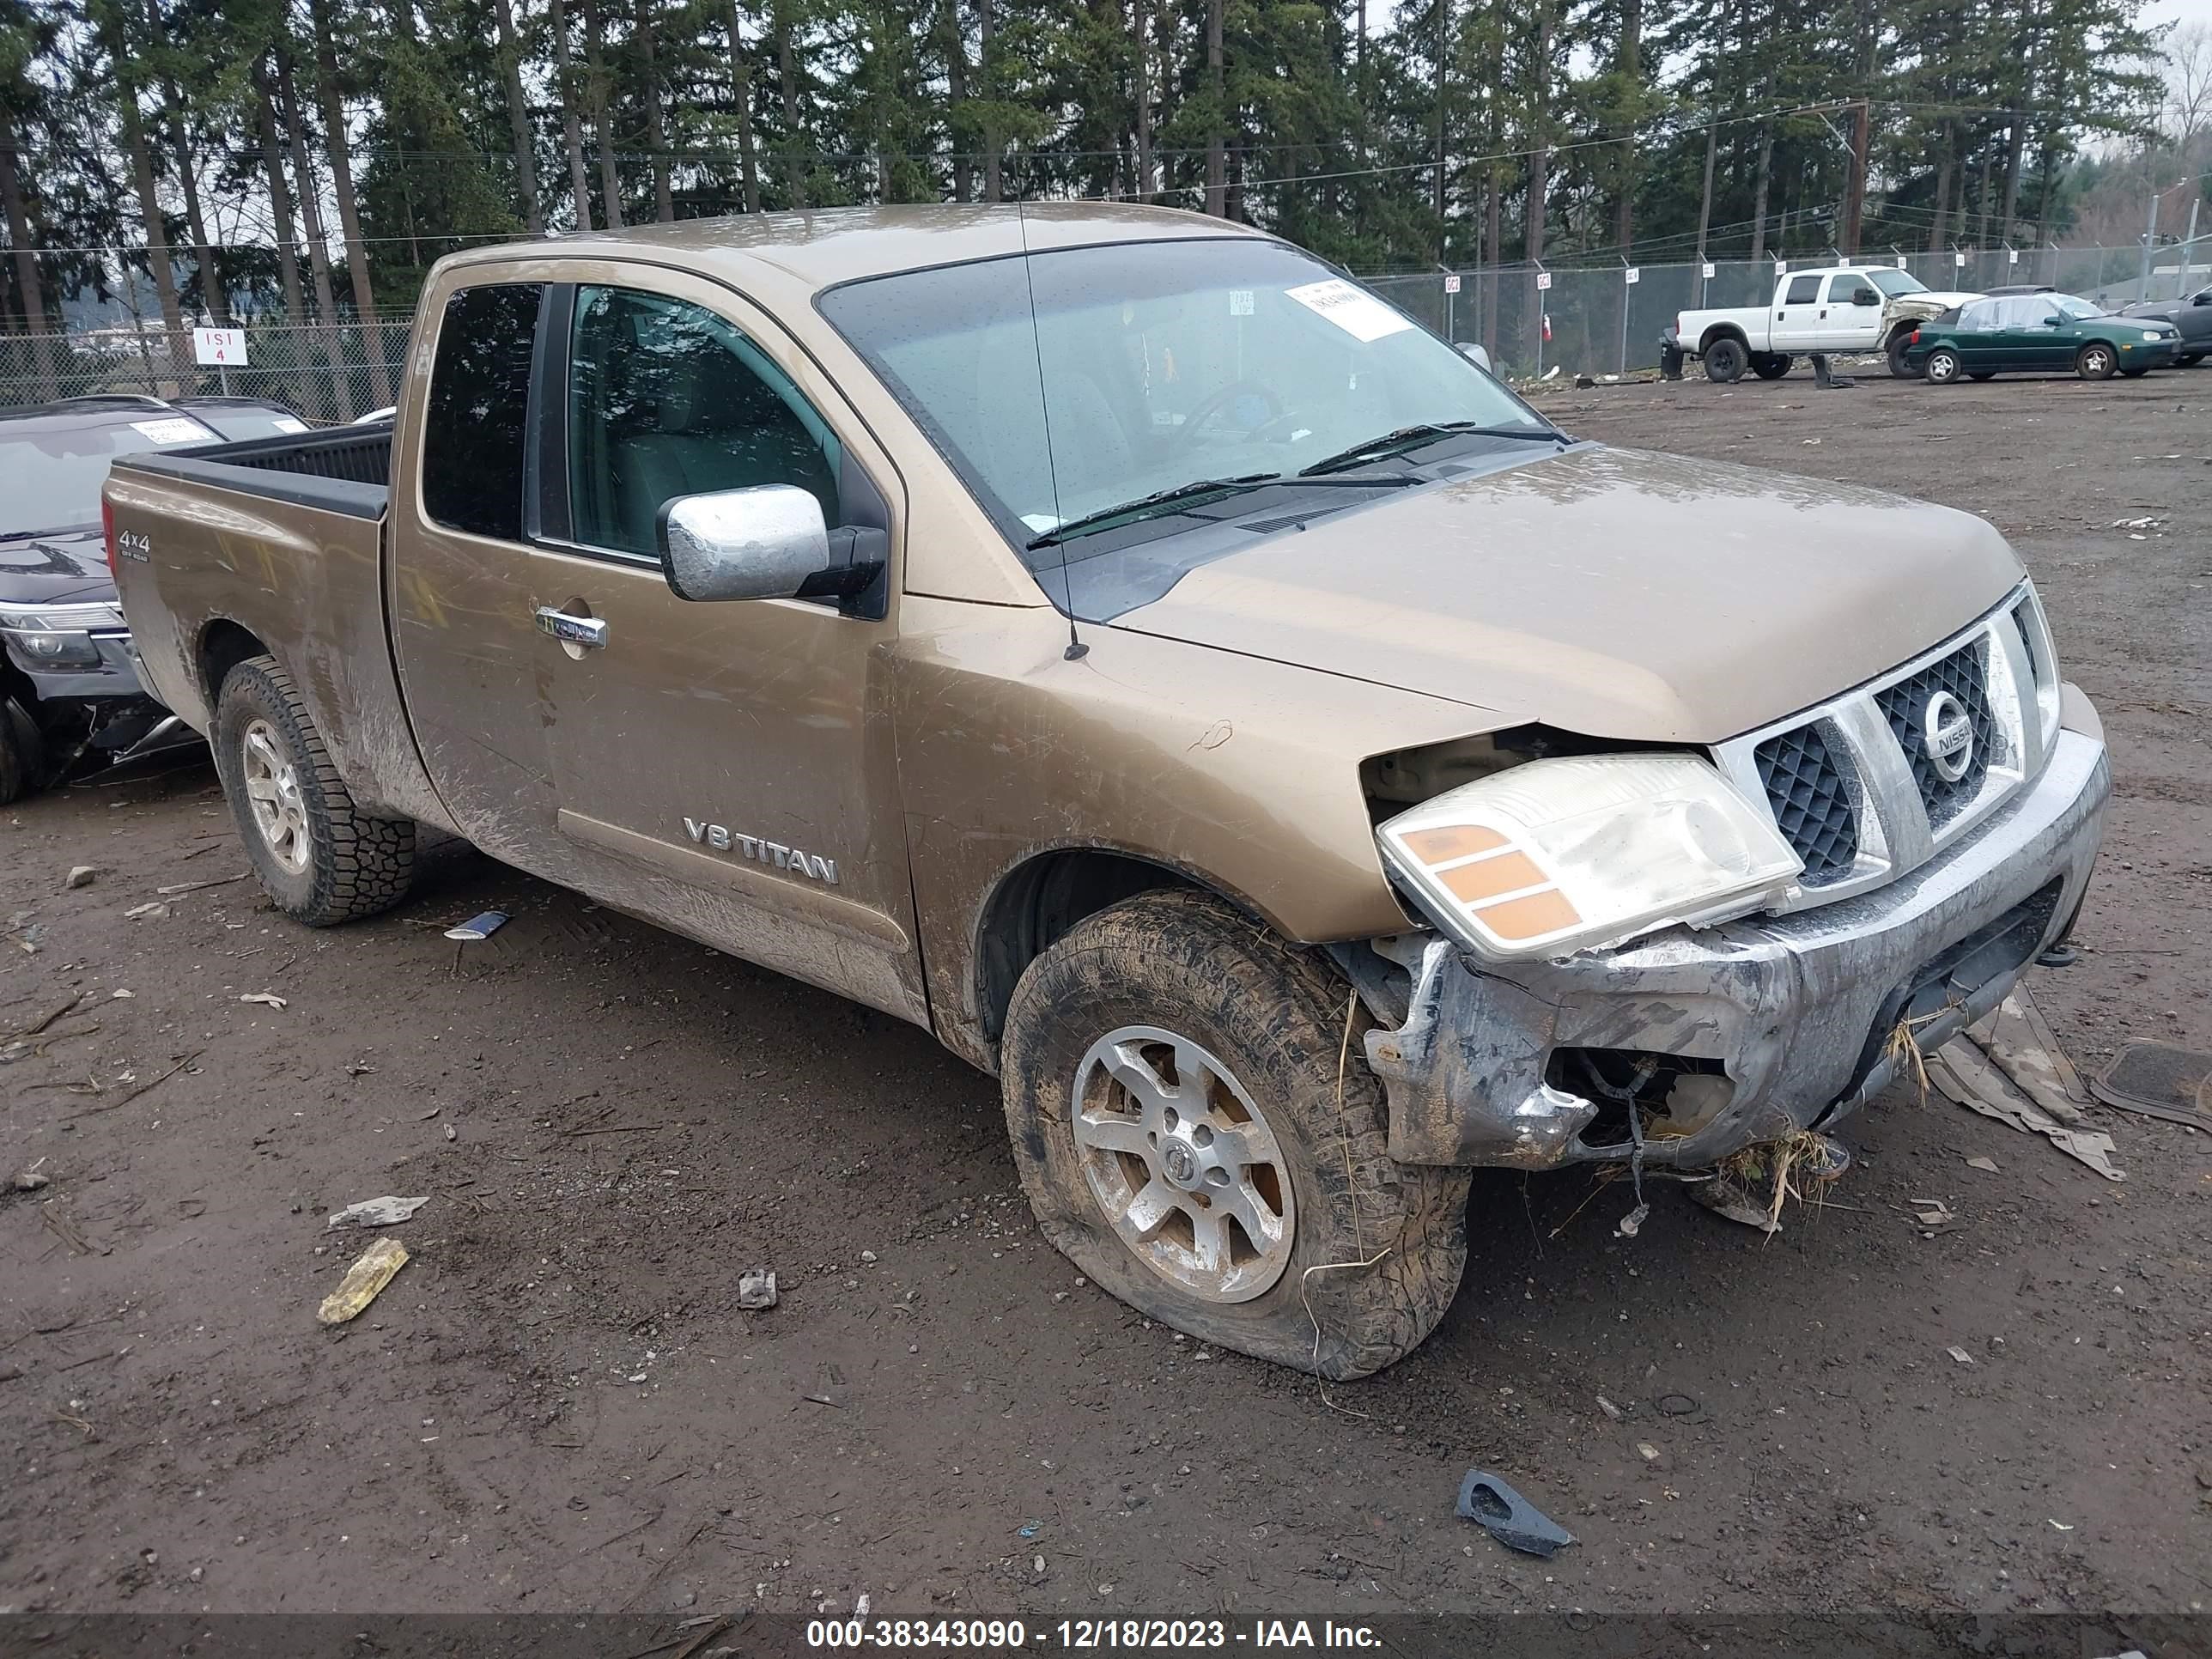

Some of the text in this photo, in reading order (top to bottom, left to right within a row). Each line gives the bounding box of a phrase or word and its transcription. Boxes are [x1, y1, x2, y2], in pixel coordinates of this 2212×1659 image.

[216, 349, 224, 362] 4
[684, 817, 839, 884] V8 TITAN
